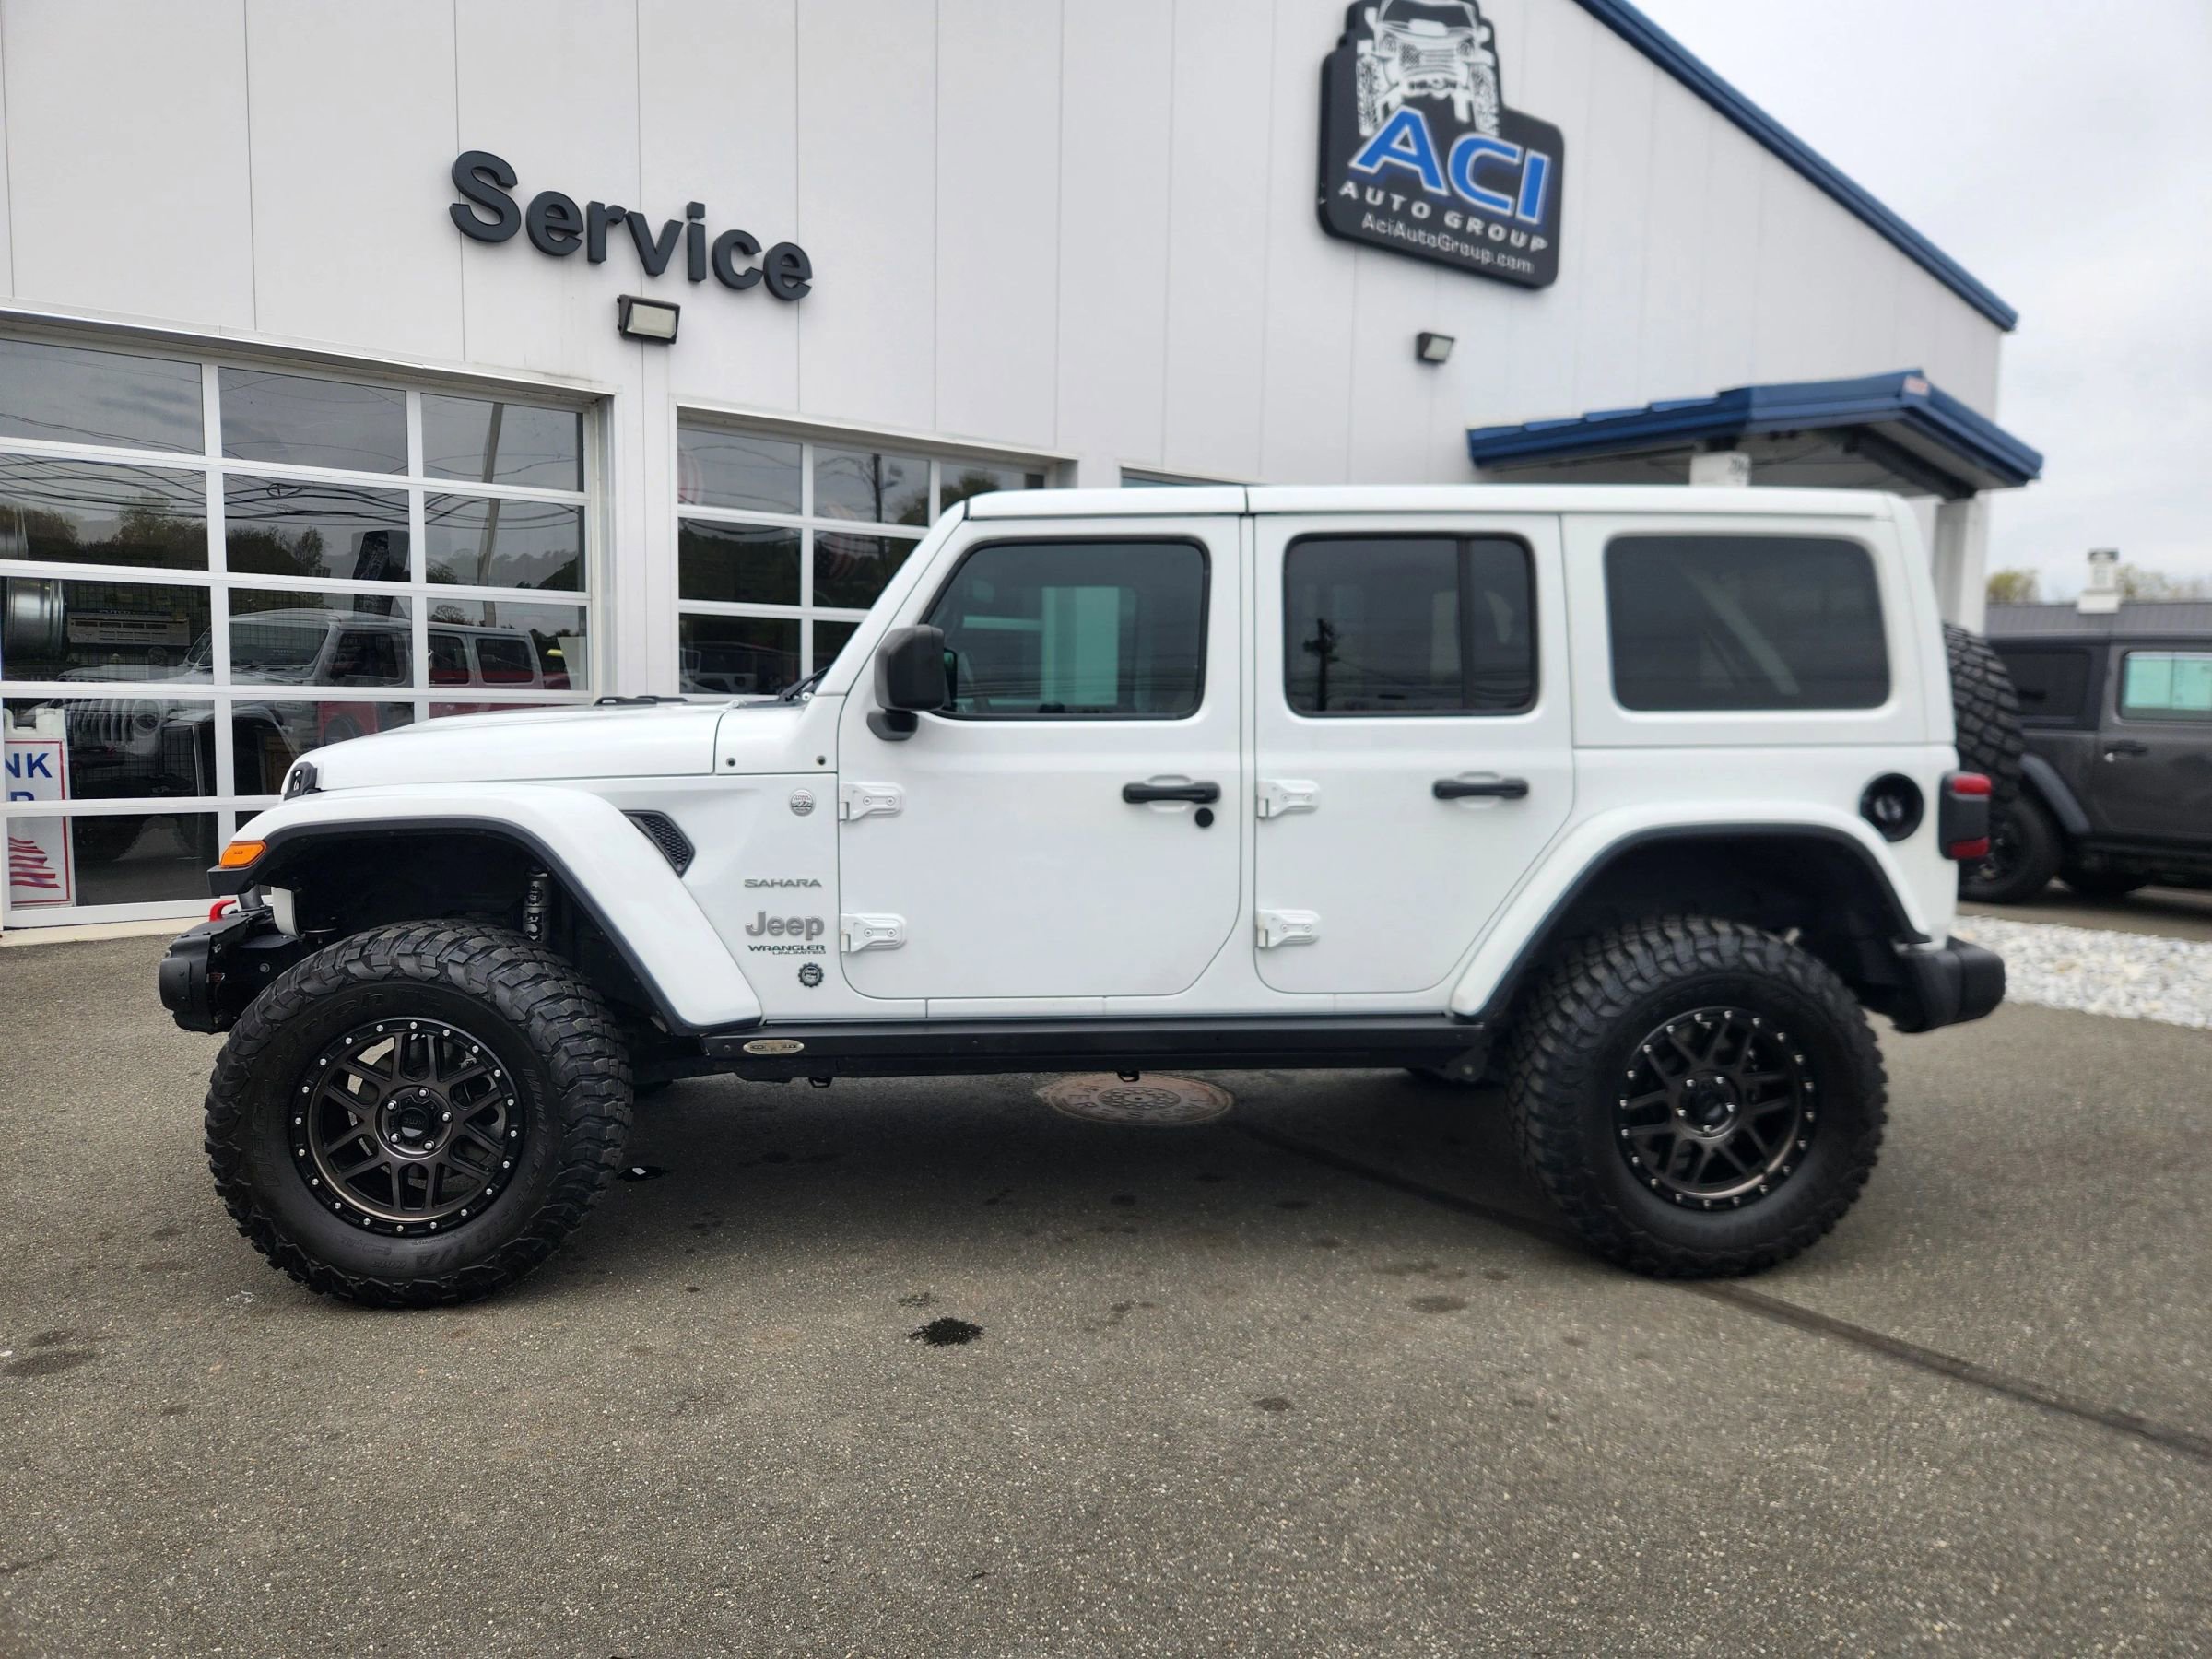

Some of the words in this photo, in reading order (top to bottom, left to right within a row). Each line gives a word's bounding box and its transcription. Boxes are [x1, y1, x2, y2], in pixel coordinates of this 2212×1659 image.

[1348, 104, 1551, 225] ACI
[449, 149, 813, 301] Service
[1338, 181, 1431, 219] AUTO
[1443, 210, 1548, 253] GROUP
[1361, 211, 1535, 275] AciAutoGroup.com
[744, 878, 822, 888] SAHARA
[745, 910, 825, 941] Jeep
[747, 944, 826, 952] WRANGLER
